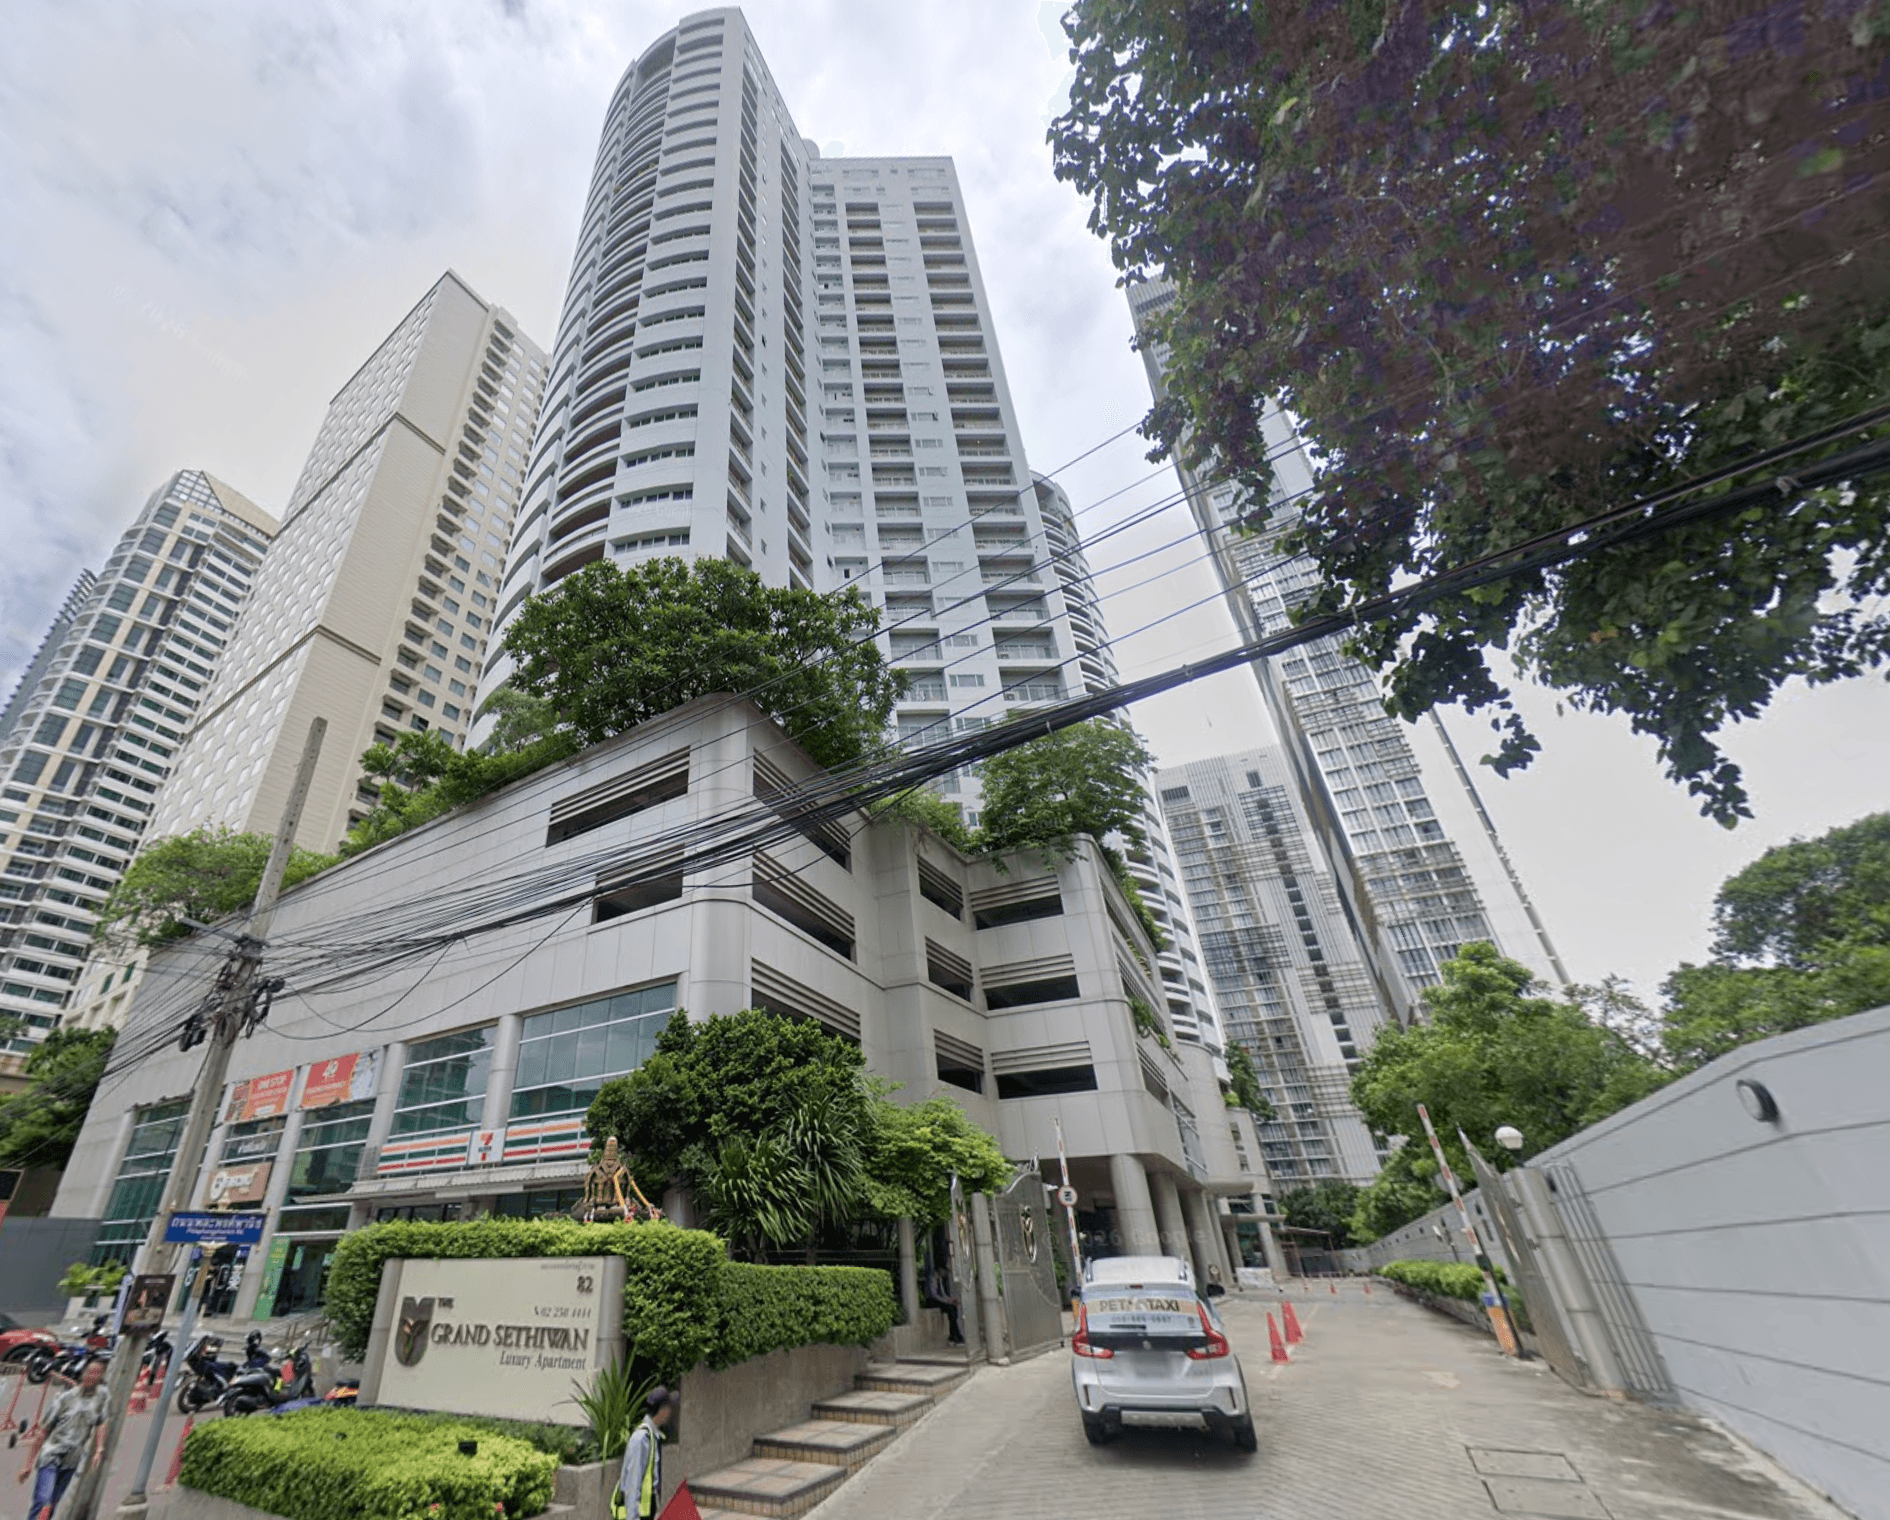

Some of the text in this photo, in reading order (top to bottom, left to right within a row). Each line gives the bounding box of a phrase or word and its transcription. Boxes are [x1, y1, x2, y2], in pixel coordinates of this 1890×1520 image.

[577, 1275, 593, 1293] 82
[438, 1297, 454, 1309] THE
[1100, 1299, 1180, 1312] PET TAXI
[432, 1323, 590, 1350] GRAND SETHIWAN
[500, 1351, 587, 1371] Luxury Apartment
